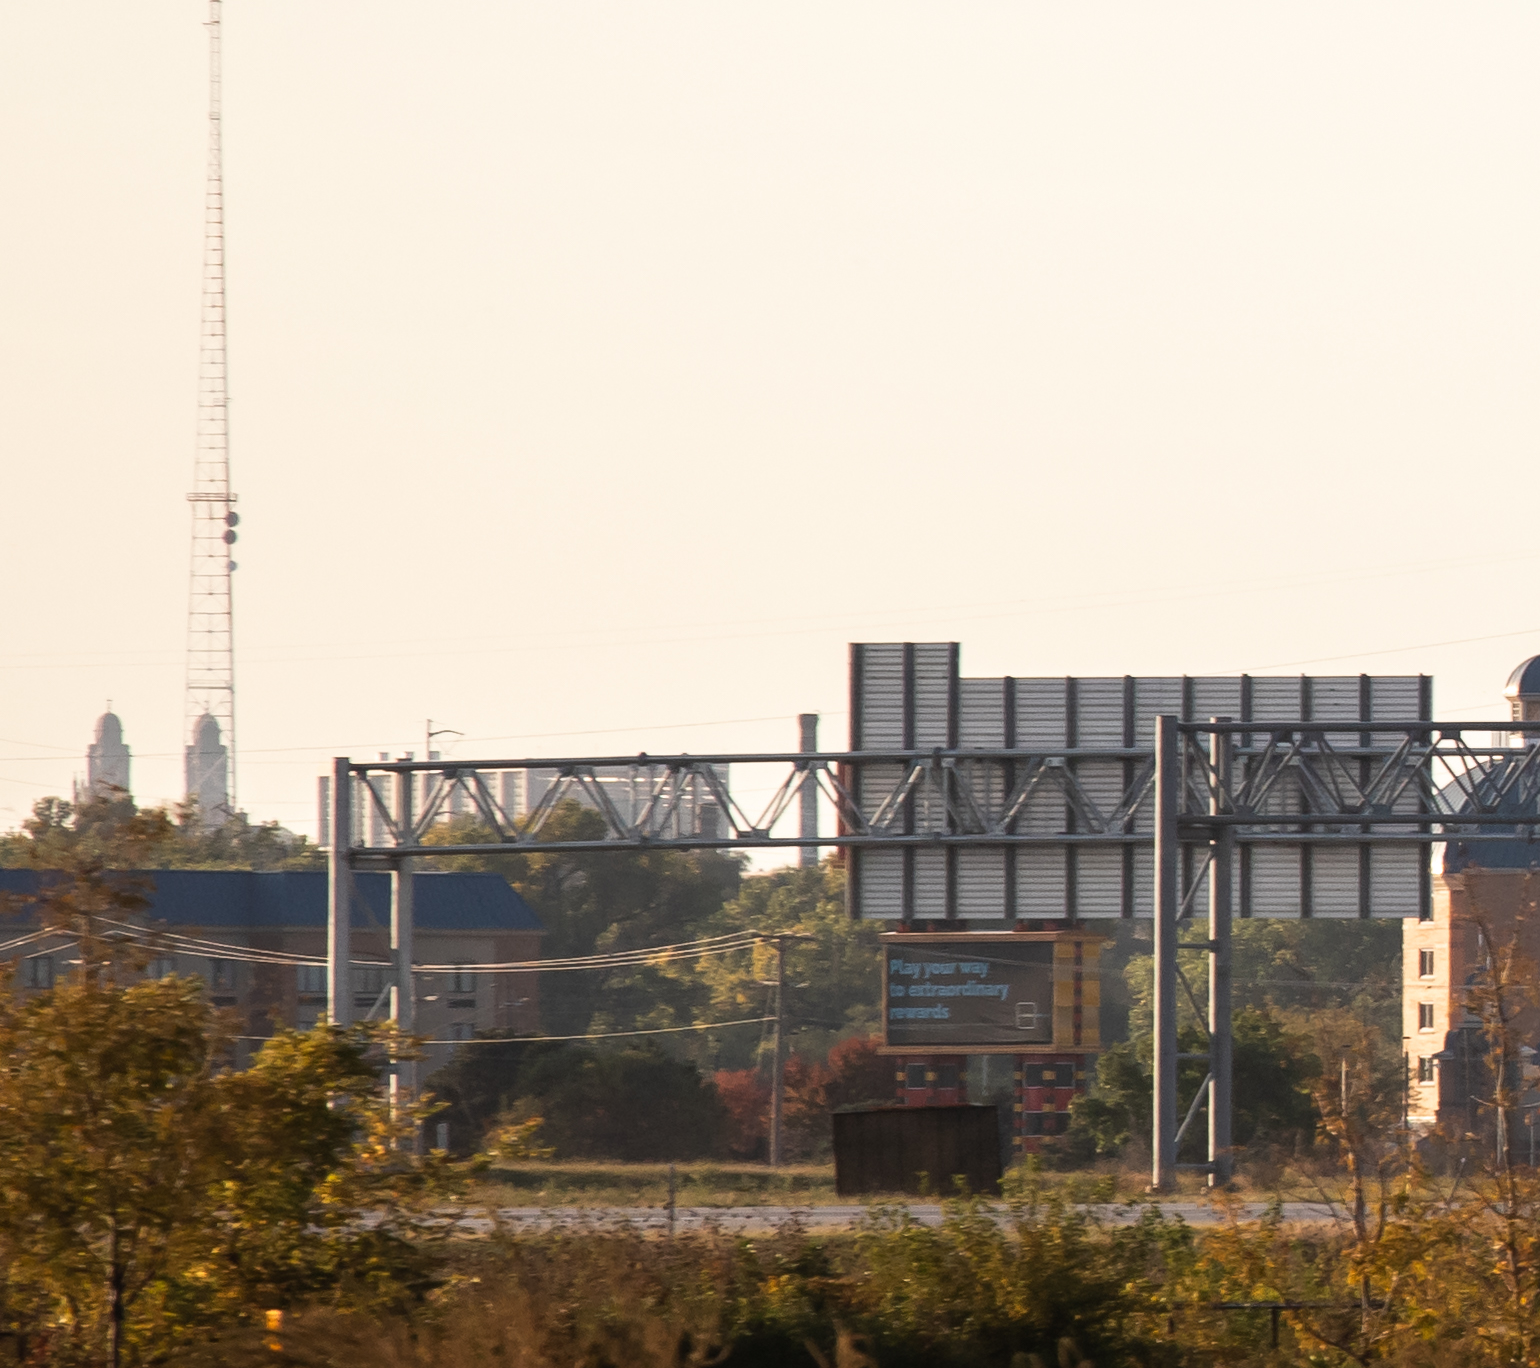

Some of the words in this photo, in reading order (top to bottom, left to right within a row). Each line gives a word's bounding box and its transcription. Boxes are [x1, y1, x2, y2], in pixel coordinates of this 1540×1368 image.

[890, 959, 921, 979] Play
[923, 962, 956, 979] your
[959, 962, 989, 978] way
